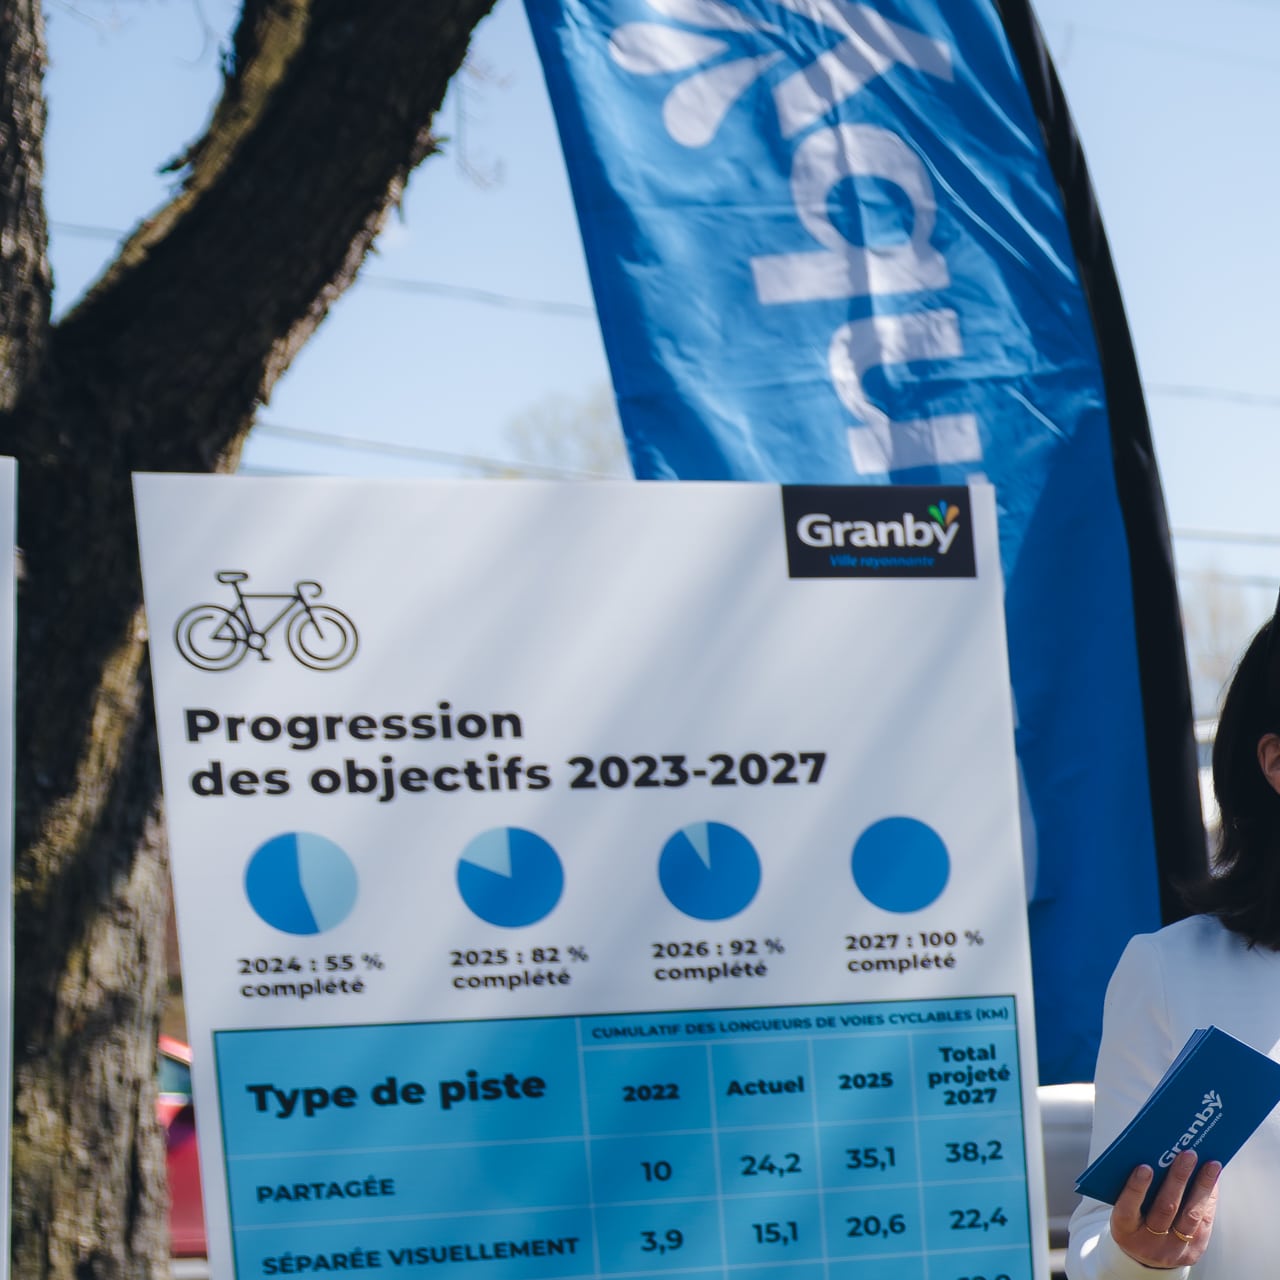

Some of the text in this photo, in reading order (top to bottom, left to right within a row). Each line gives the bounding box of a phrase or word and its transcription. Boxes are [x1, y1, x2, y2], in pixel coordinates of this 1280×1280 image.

[797, 512, 960, 554] Granby
[185, 701, 523, 750] Progression
[191, 752, 827, 802] des objectifs 2023-2027
[652, 940, 709, 958] 2026
[732, 938, 759, 956] 92
[764, 937, 785, 954] %
[845, 933, 899, 951] 2027
[920, 931, 957, 949] 100
[964, 930, 984, 947] %
[238, 955, 301, 974] 2024
[326, 954, 354, 971] 55
[363, 953, 384, 970] %
[449, 948, 510, 967] 2025
[533, 946, 561, 963] 82
[567, 945, 588, 961] %
[848, 952, 956, 975] complété
[453, 968, 571, 992] complété
[654, 960, 767, 984] complété
[241, 976, 365, 999] complété
[591, 1005, 1009, 1040] CUMULATIF DES LONGUEURS DE VOIES CYCLABLES (KM)
[938, 1044, 996, 1063] Total
[726, 1076, 805, 1098] Actuel
[838, 1071, 894, 1090] 2025
[928, 1062, 1011, 1089] projeté
[246, 1070, 546, 1119] Type de piste
[622, 1082, 680, 1102] 2022
[943, 1086, 997, 1106] 2027
[1158, 1093, 1223, 1168] Granby
[1192, 1112, 1223, 1148] rayonnante
[846, 1146, 896, 1173] 35,1
[945, 1140, 1003, 1165] 38,2
[640, 1160, 672, 1182] 10
[740, 1153, 802, 1178] 24,2
[256, 1174, 396, 1204] PARTAGÉE
[846, 1213, 907, 1239] 20,6
[949, 1207, 1008, 1232] 22,4
[640, 1229, 684, 1255] 3,9
[752, 1221, 798, 1248] 15,1
[262, 1237, 579, 1276] SÉPARÉE VISUELLEMENT
